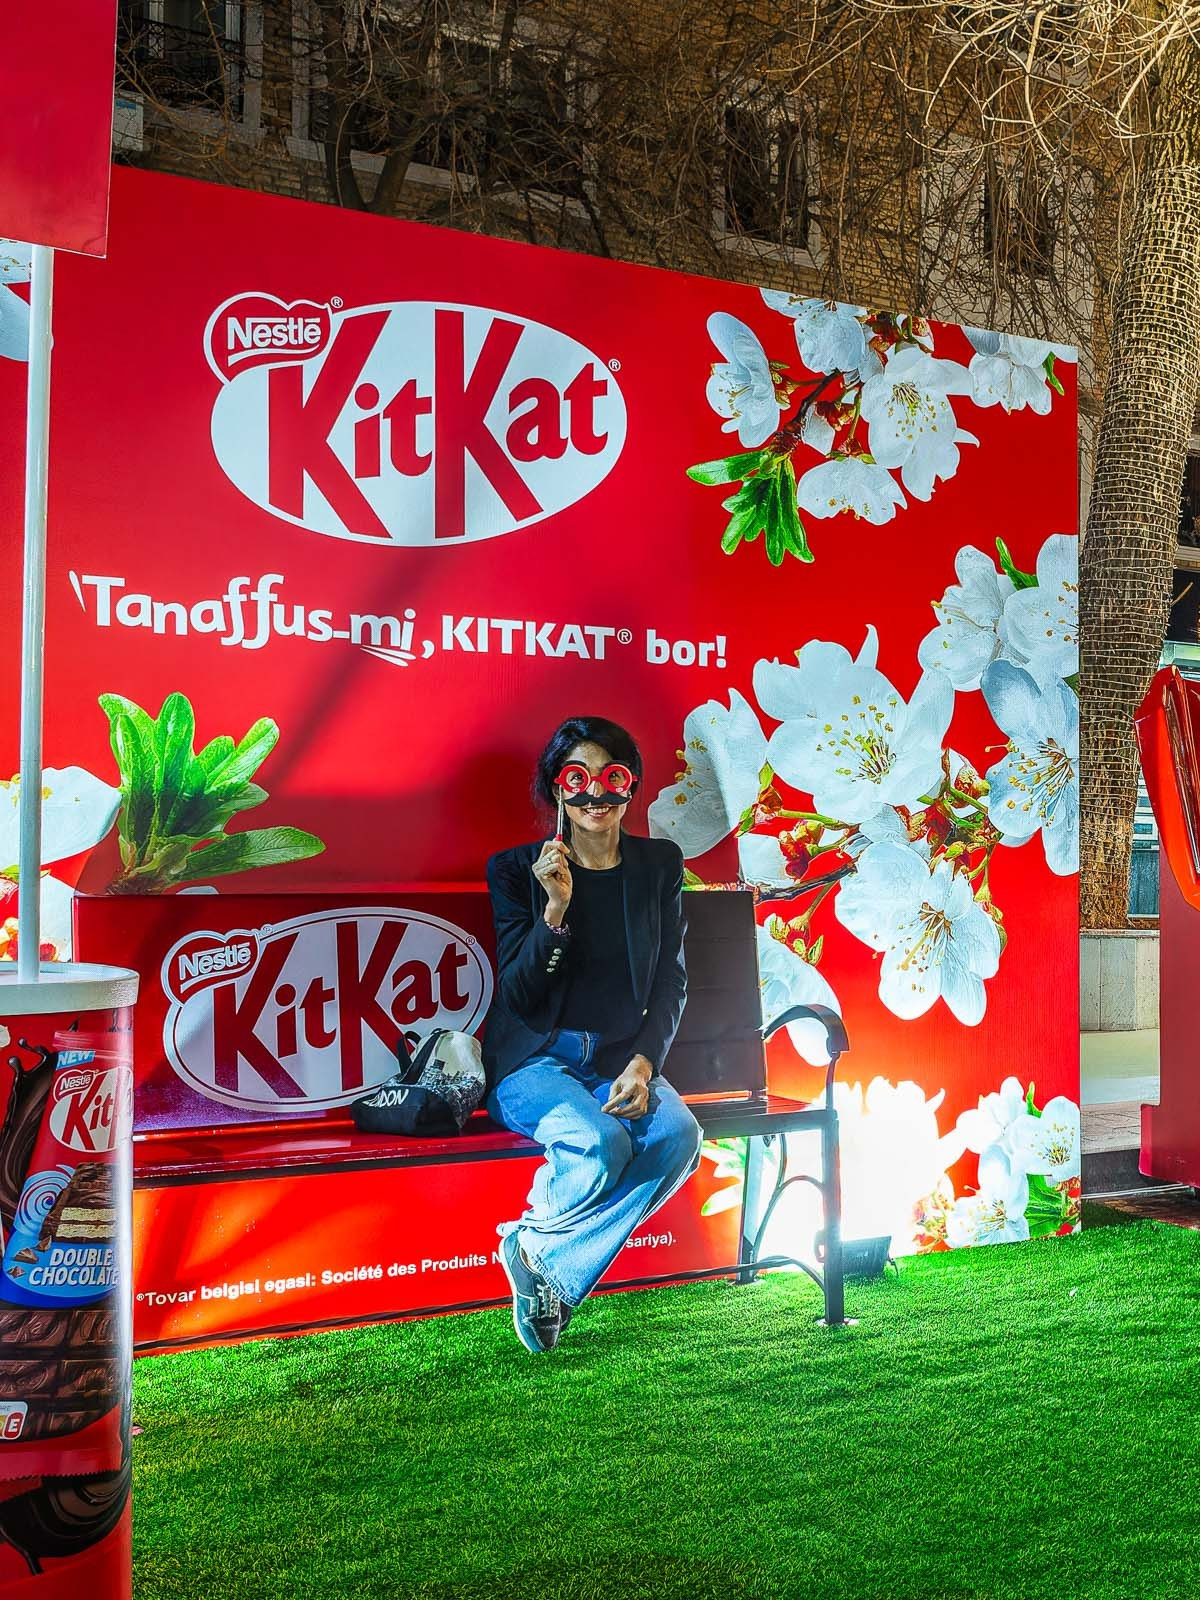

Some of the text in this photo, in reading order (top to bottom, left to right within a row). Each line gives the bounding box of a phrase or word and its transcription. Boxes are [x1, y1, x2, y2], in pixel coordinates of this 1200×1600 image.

[268, 309, 608, 538] KitKat
[646, 629, 727, 669] bor!
[212, 920, 470, 1099] KitKat
[57, 1050, 92, 1066] NEW
[49, 1248, 114, 1267] DOUBLE
[201, 1278, 260, 1301] belgisi
[264, 1273, 316, 1294] egasi:
[321, 1264, 383, 1285] Société
[387, 1263, 417, 1278] des
[421, 1254, 487, 1273] Produits
